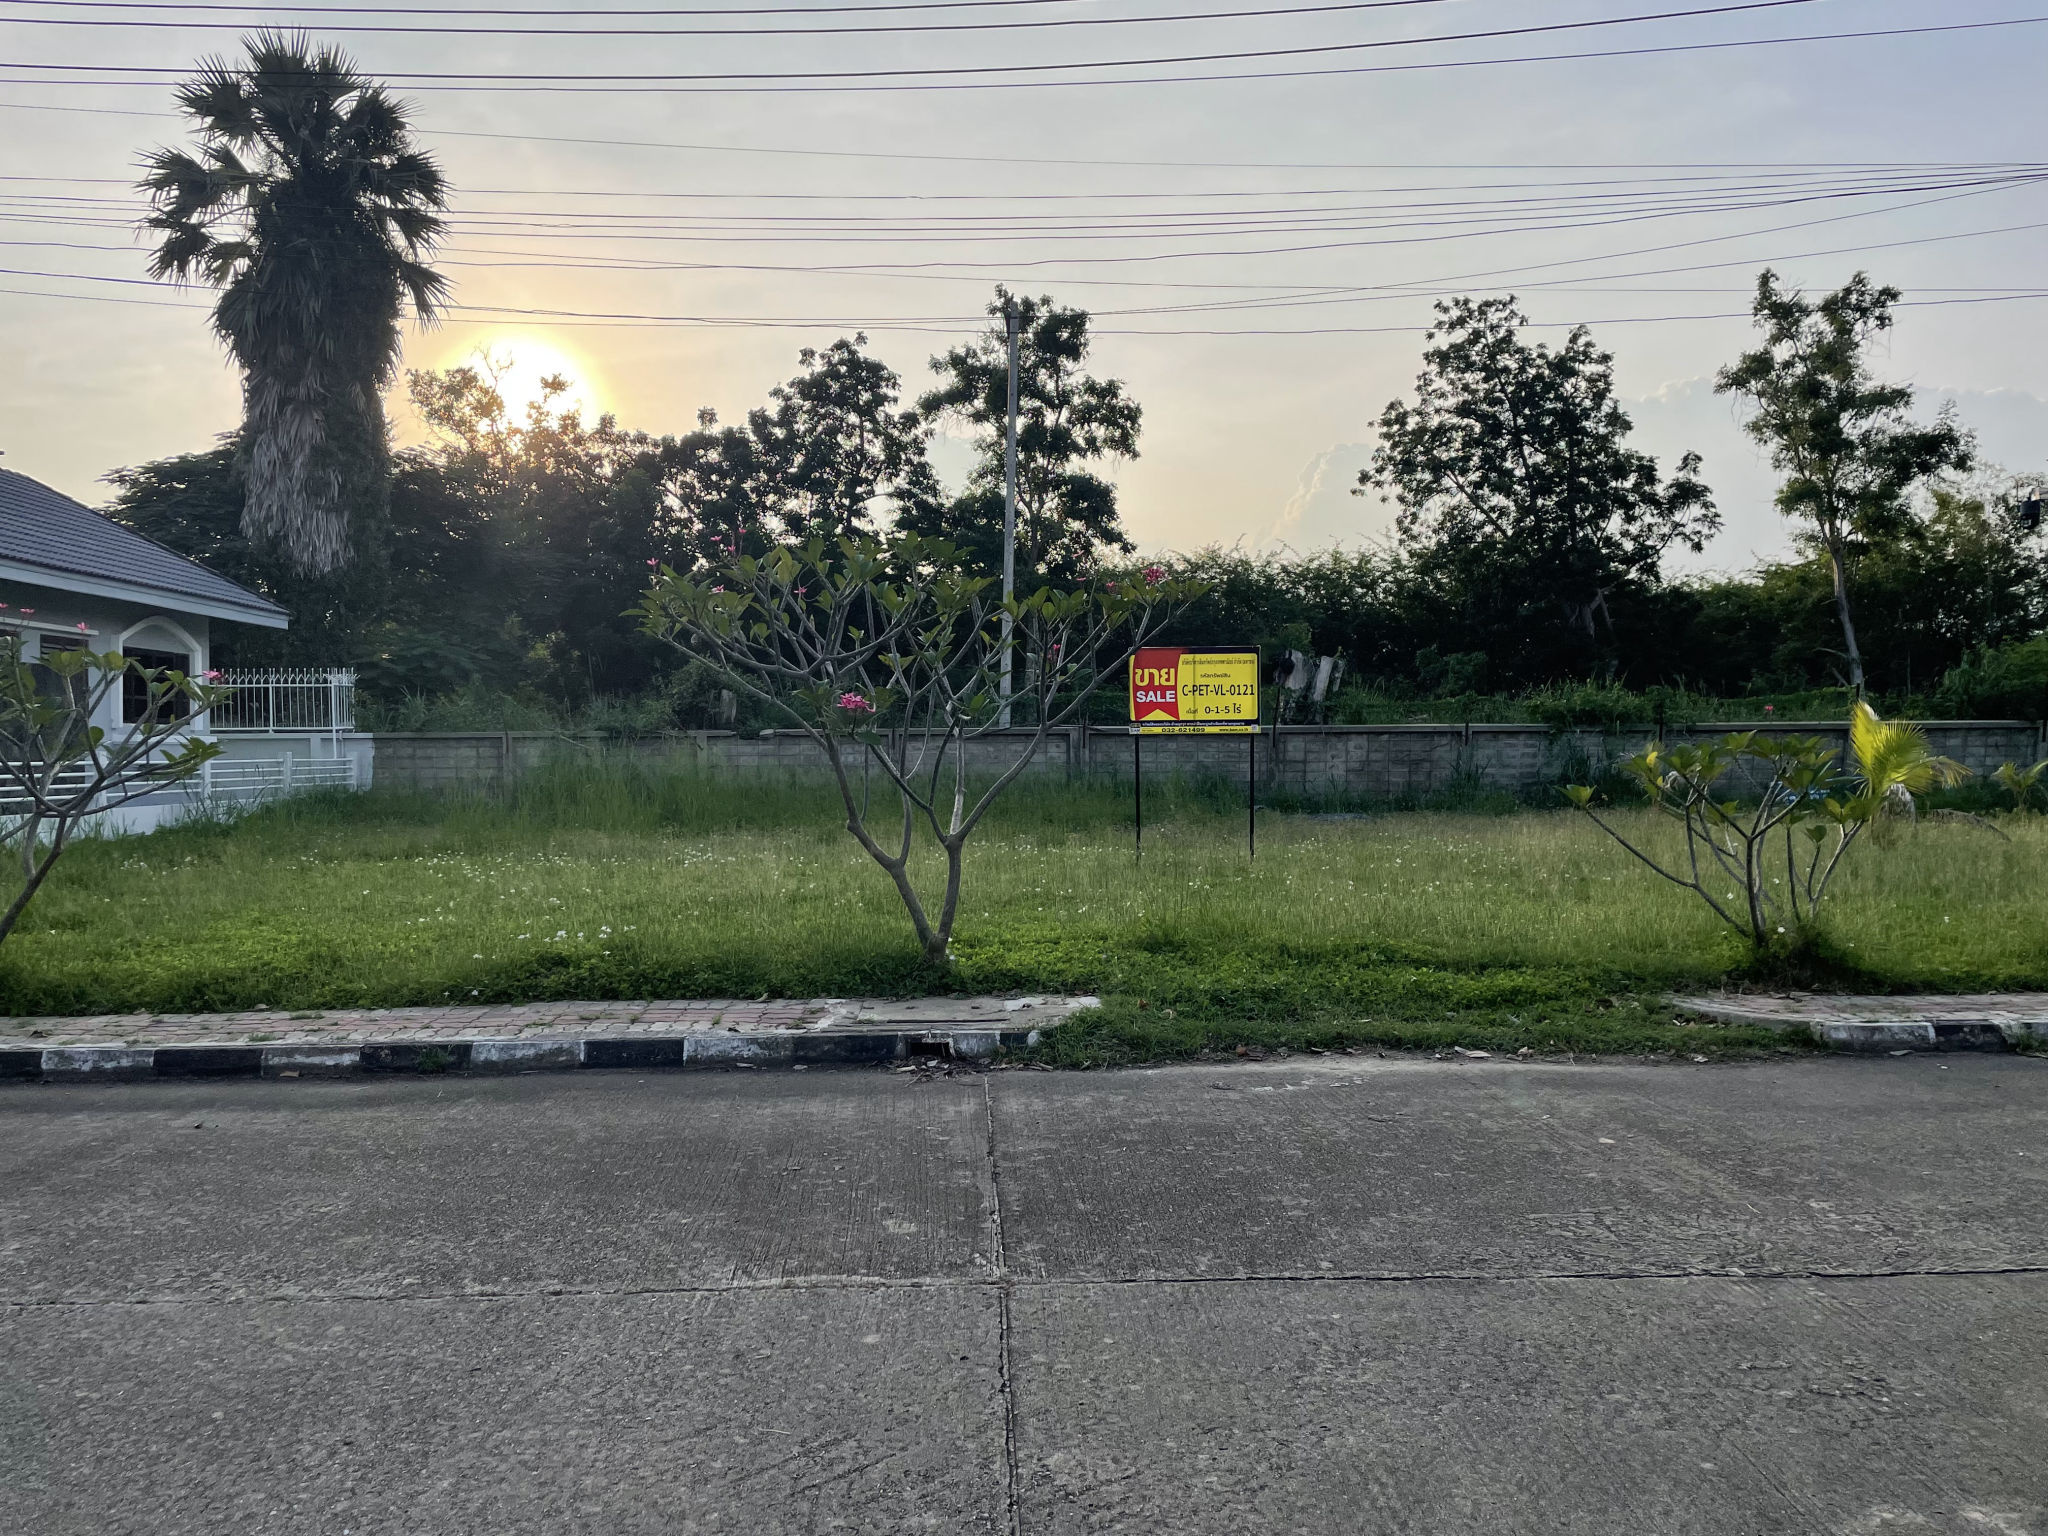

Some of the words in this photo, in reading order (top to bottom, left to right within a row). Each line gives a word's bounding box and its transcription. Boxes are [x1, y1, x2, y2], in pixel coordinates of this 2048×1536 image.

[1135, 668, 1175, 686] ขาย
[1182, 684, 1255, 696] C-PET-VL-0121
[1136, 690, 1176, 703] SALE
[1204, 705, 1230, 714] 0-1-5
[1232, 703, 1242, 714] ไร่
